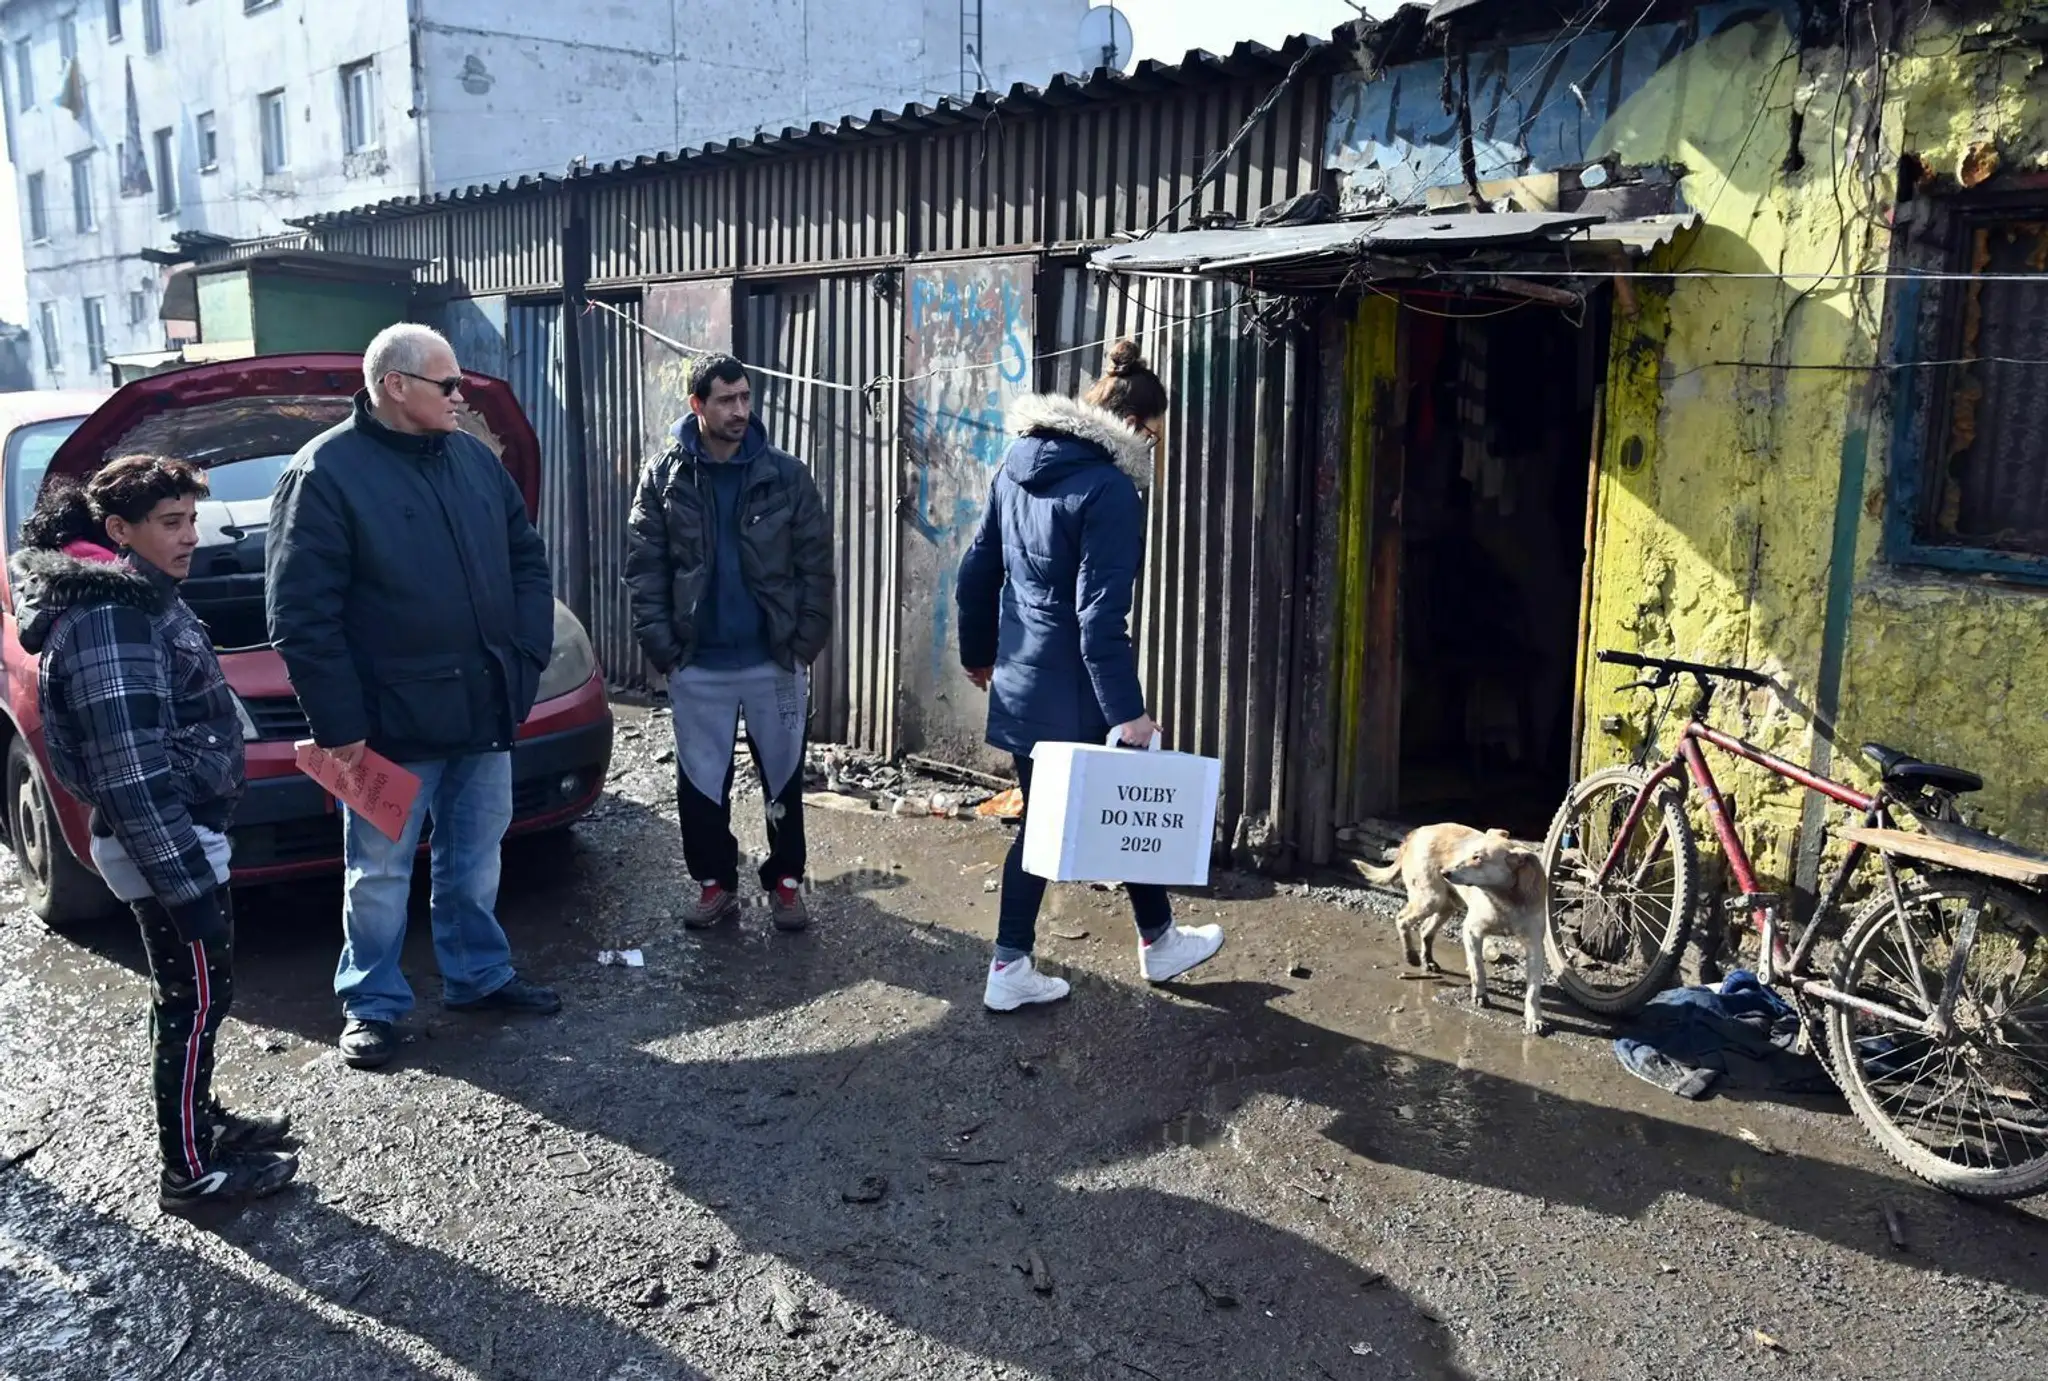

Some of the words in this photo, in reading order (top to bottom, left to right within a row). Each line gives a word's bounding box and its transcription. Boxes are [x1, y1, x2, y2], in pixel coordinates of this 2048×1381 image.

[383, 800, 402, 818] 3
[1100, 809, 1128, 826] DO
[1132, 811, 1157, 827] NR
[1161, 812, 1184, 829] SR
[1120, 836, 1161, 853] 2020
